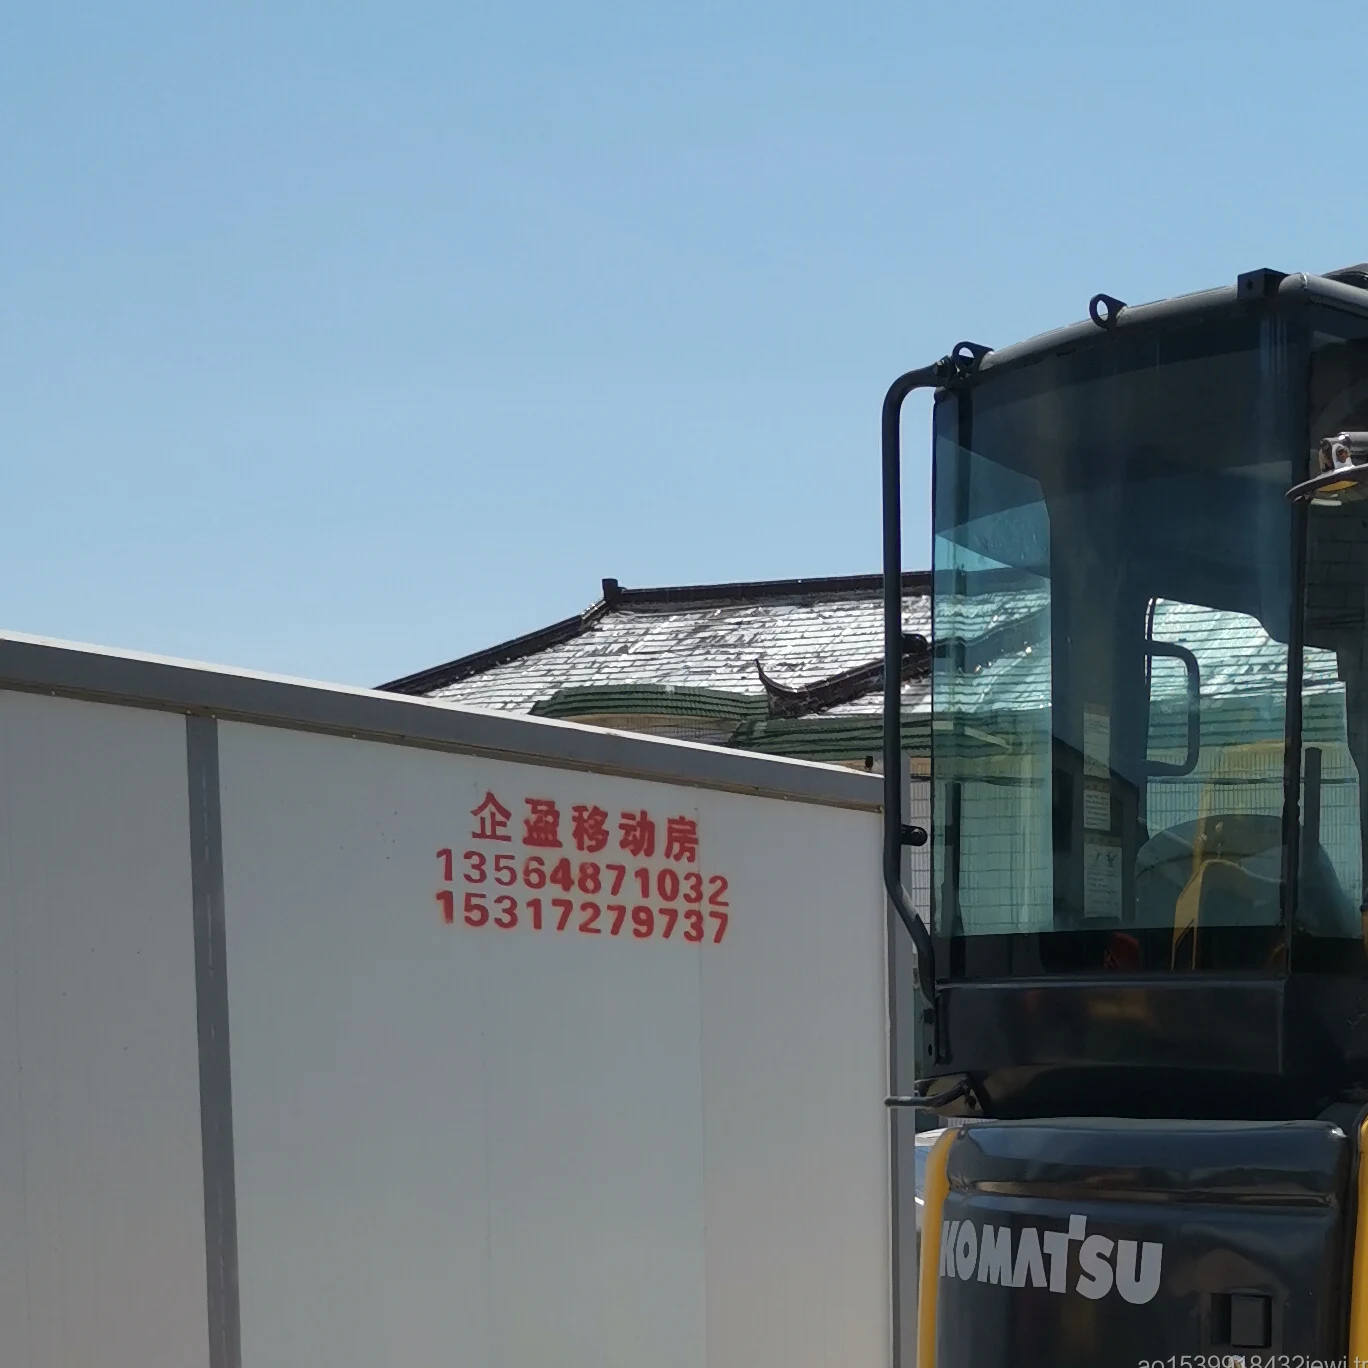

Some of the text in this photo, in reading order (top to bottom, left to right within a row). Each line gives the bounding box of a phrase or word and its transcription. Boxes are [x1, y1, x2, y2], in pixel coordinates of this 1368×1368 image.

[470, 791, 699, 863] 企盈移动房
[436, 848, 729, 907] 13564871032
[436, 890, 729, 944] 15317279737
[939, 1213, 1163, 1305] KOMATSU
